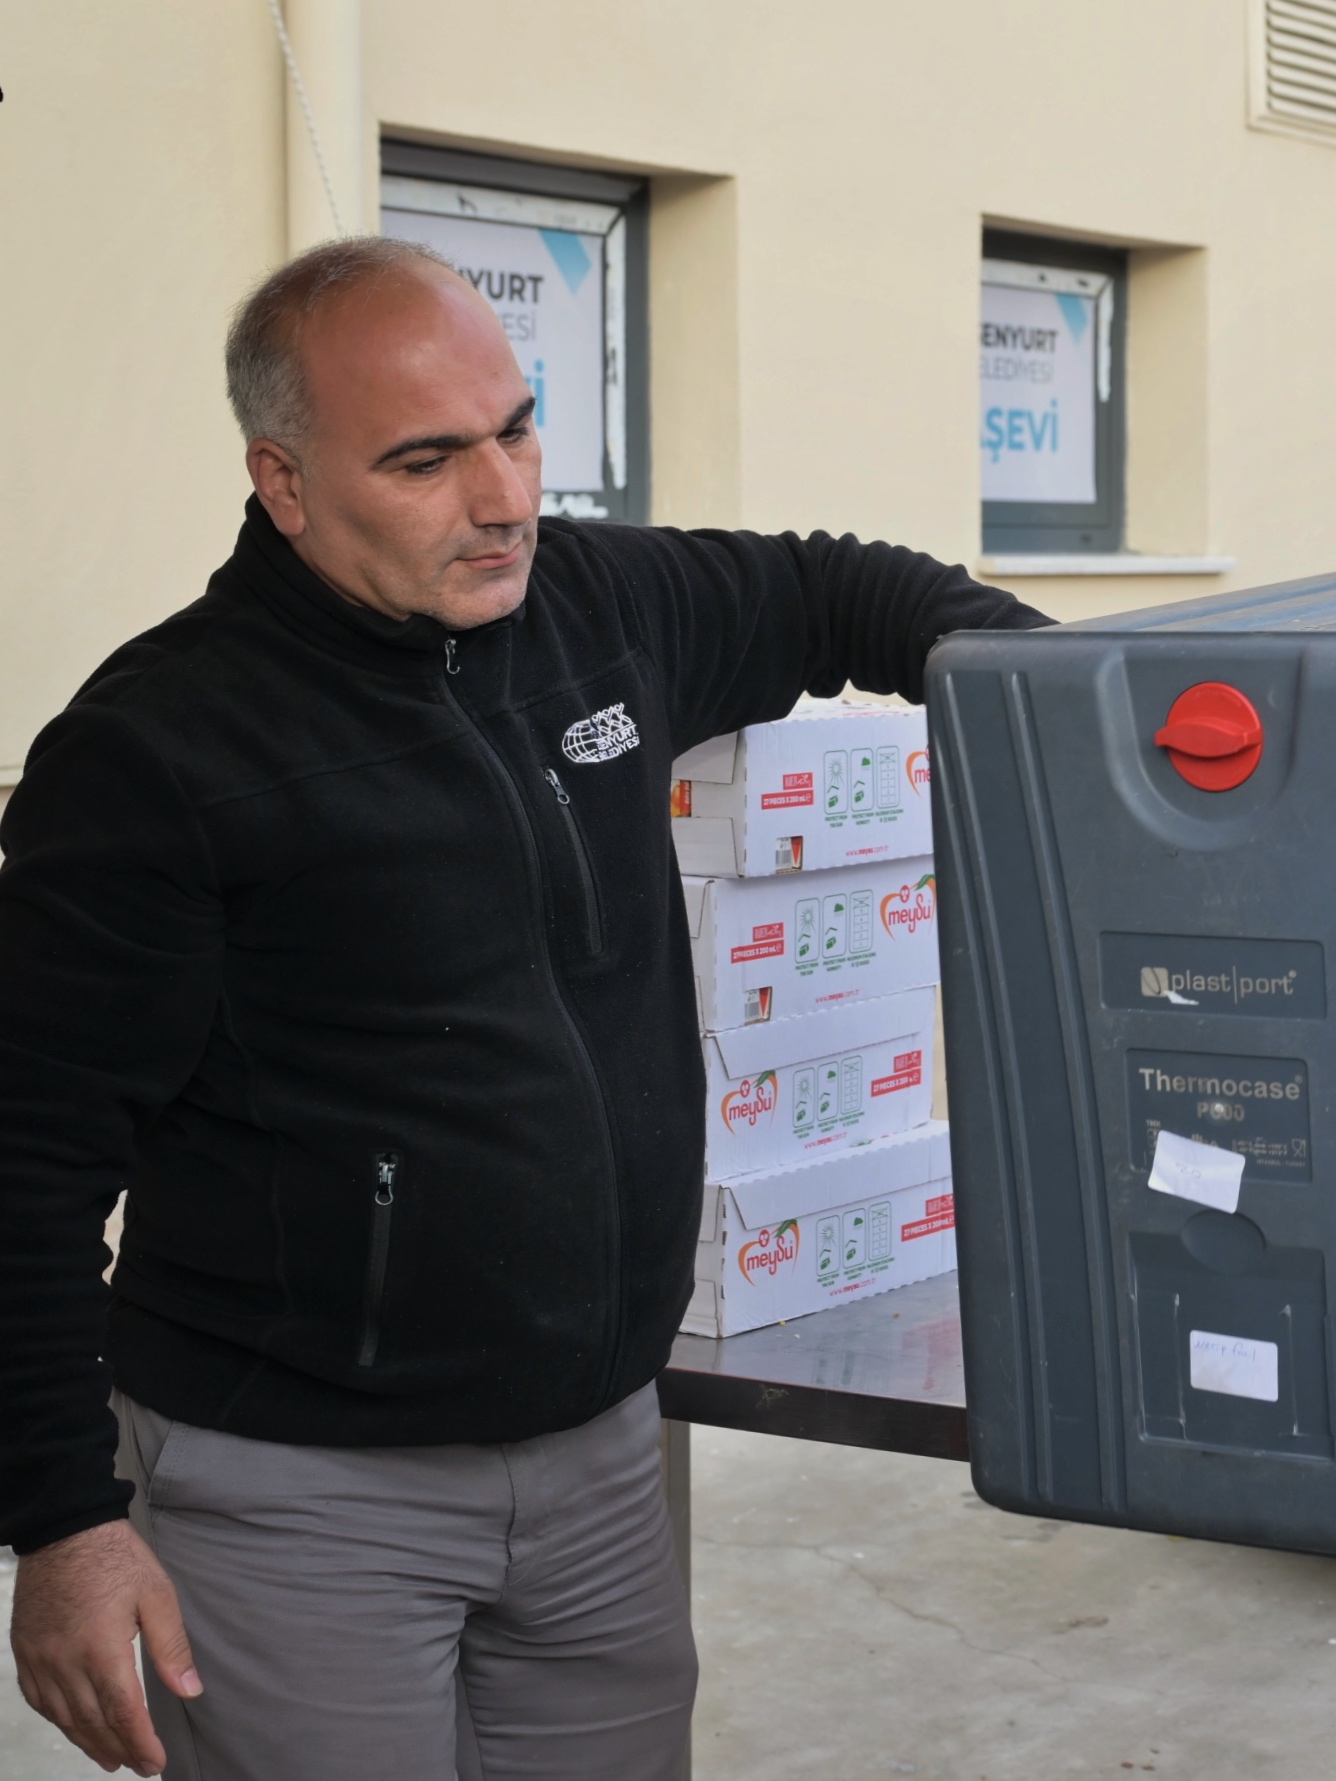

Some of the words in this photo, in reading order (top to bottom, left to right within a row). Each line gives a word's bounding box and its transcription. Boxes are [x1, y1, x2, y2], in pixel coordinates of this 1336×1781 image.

[458, 267, 544, 304] YURT
[981, 322, 1059, 353] ENYURT
[980, 397, 1058, 463] ŞEVİ
